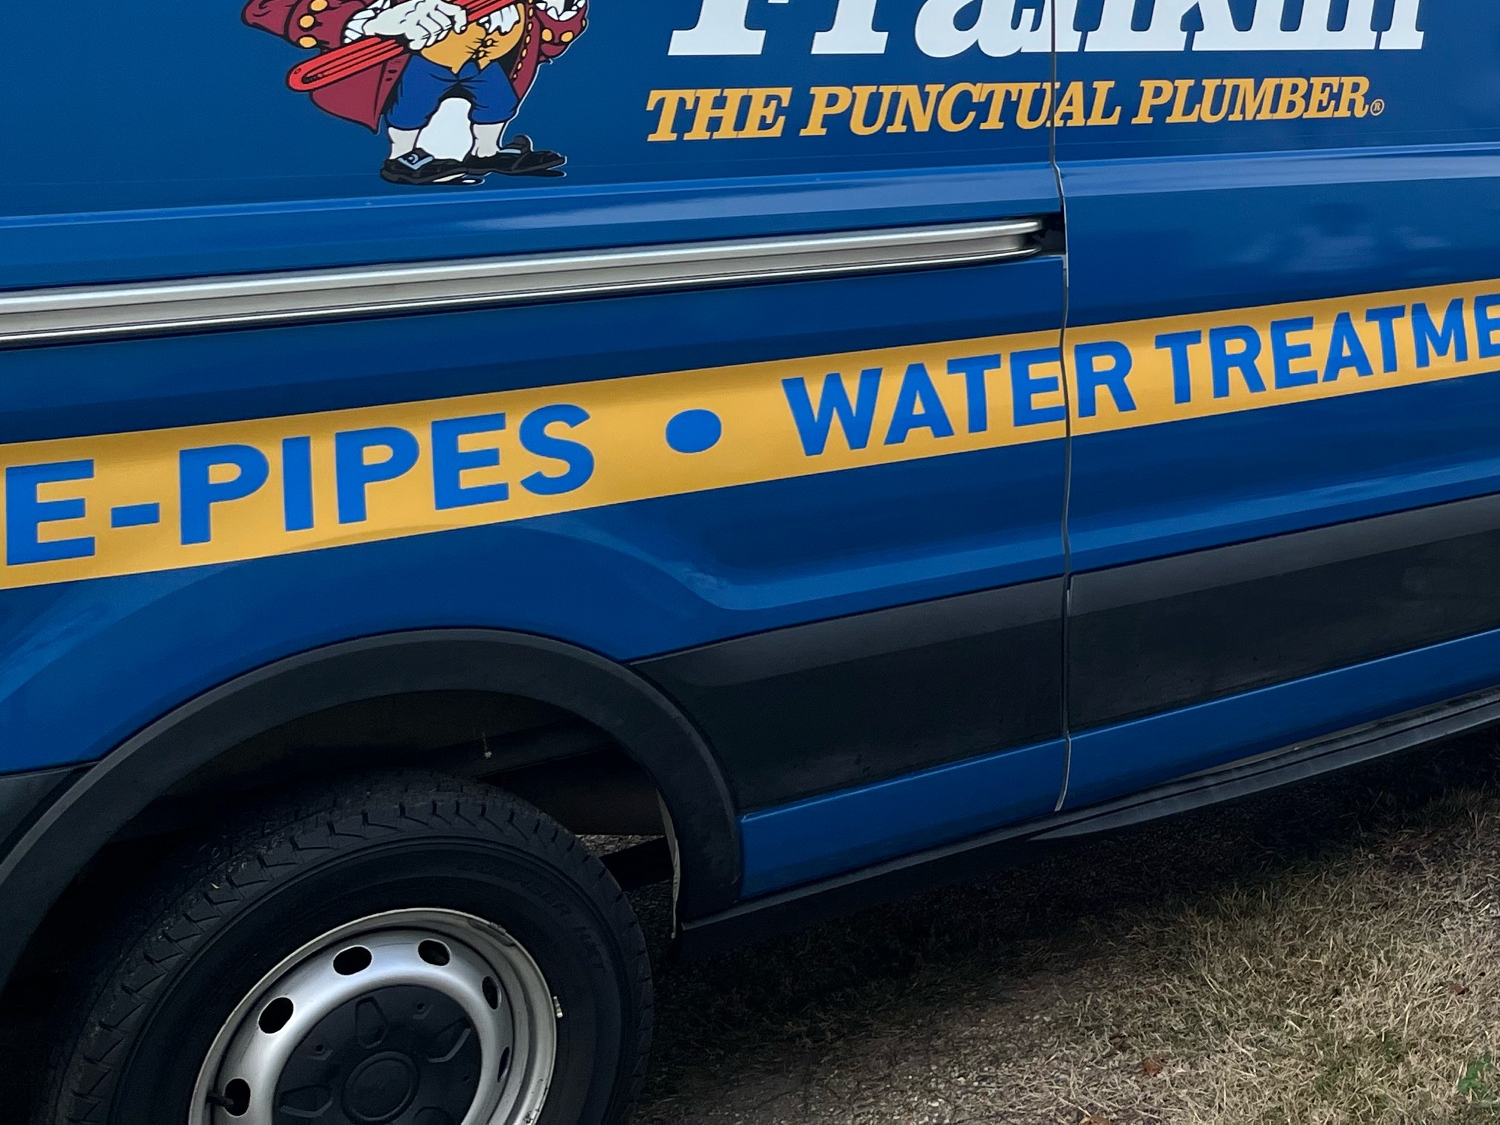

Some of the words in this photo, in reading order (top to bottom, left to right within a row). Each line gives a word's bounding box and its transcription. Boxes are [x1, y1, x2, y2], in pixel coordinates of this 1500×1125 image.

[646, 86, 793, 142] THE
[799, 80, 1120, 136] PUNCTUAL
[781, 339, 1136, 458] WATER
